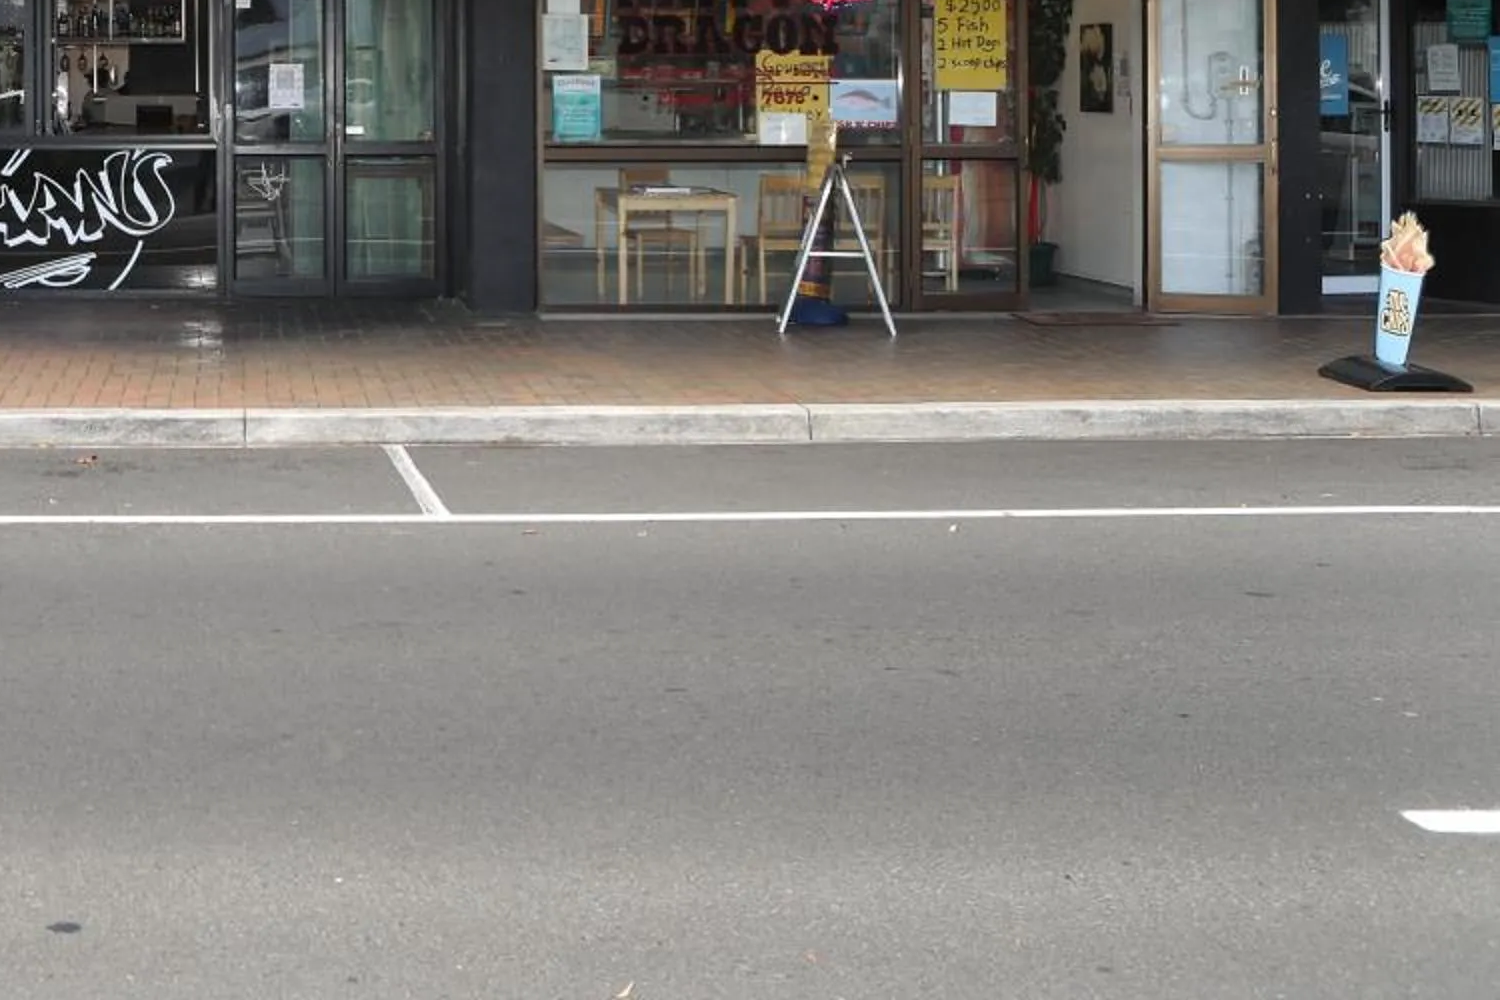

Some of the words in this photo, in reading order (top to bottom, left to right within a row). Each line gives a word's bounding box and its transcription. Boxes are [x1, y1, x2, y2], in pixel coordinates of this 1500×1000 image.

[618, 12, 839, 54] DRAGON
[957, 15, 989, 33] Fish
[951, 37, 972, 50] Hot
